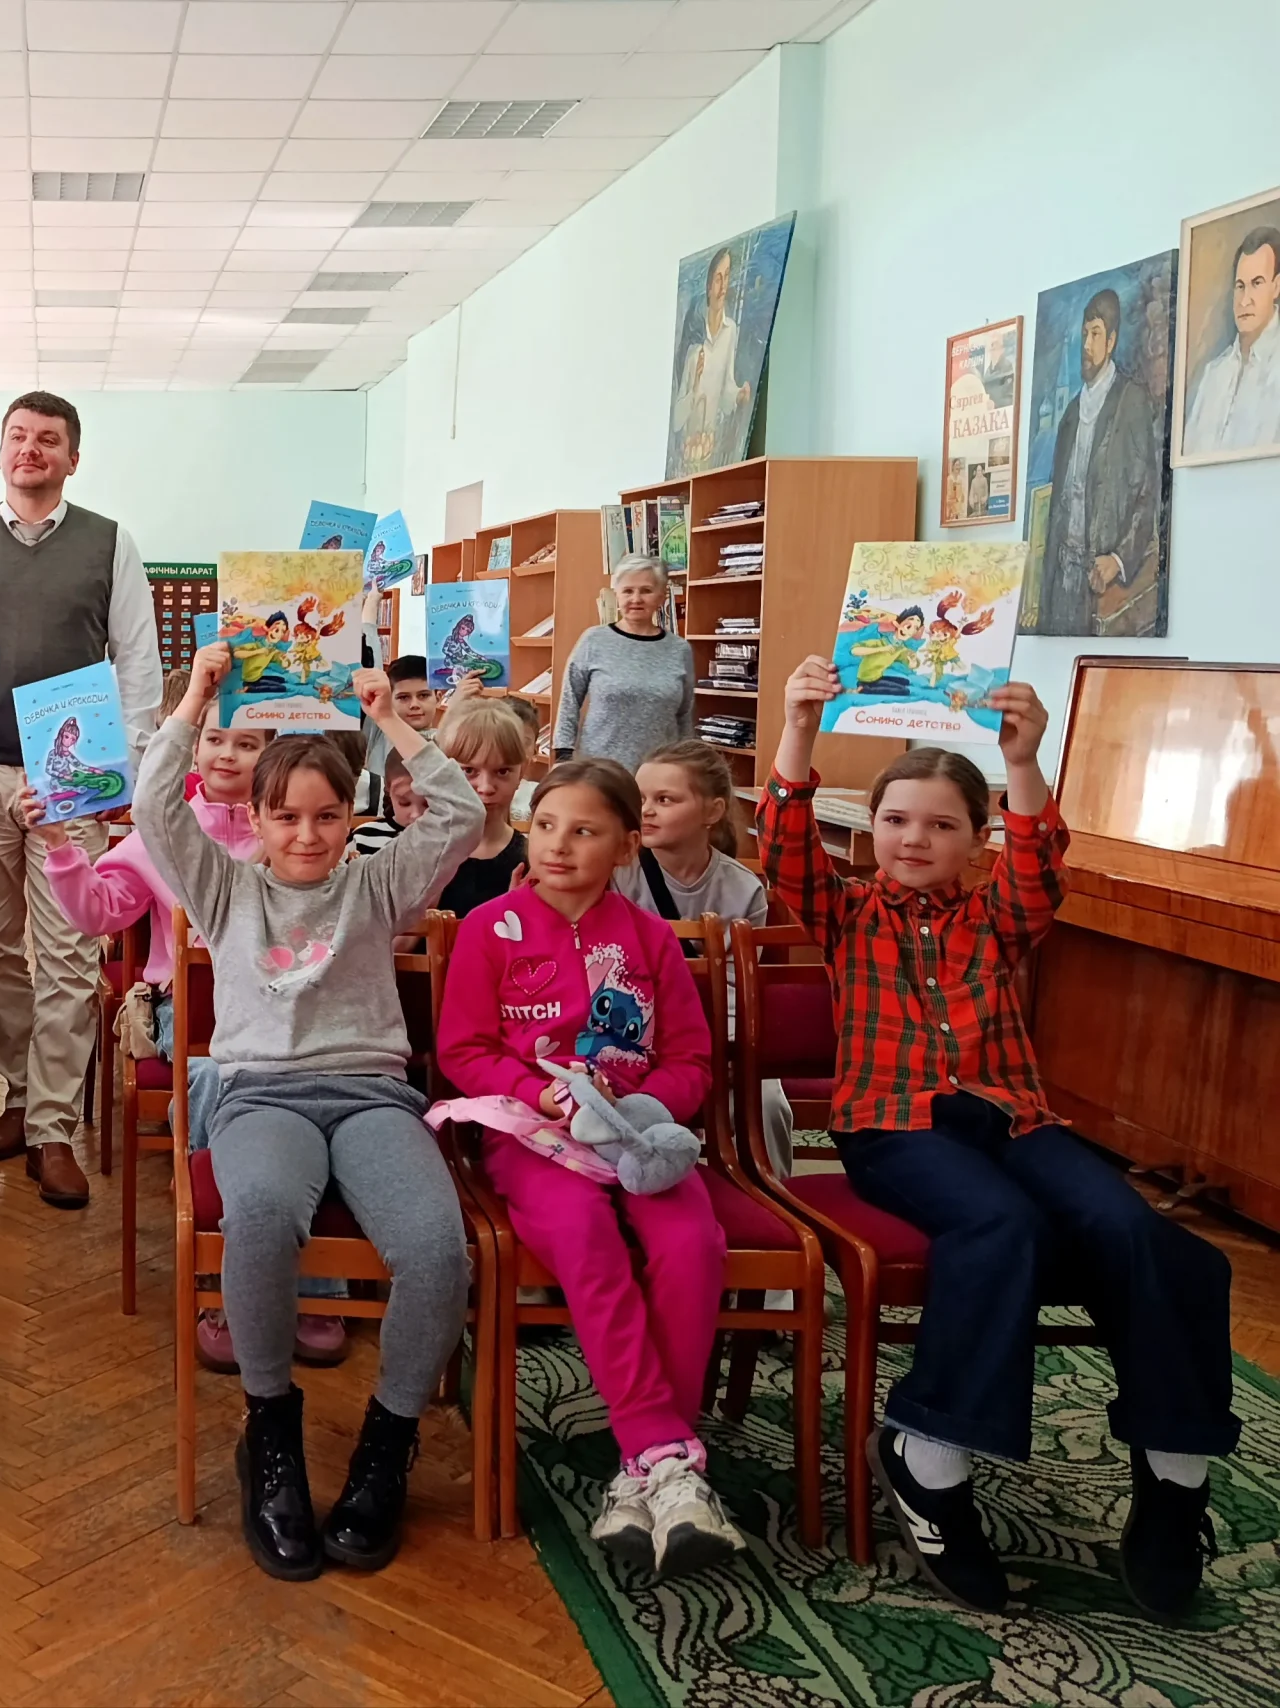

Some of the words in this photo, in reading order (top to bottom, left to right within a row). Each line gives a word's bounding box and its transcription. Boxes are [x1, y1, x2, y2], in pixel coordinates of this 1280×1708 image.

[951, 393, 984, 411] Сяргея
[953, 409, 1009, 439] КАЗАКА
[144, 566, 178, 575] АФІЧНЫ
[180, 567, 214, 575] АПАРАТ
[431, 602, 460, 613] ДЕВОЧКА
[24, 704, 59, 724] ДЕВОЧКА
[68, 694, 108, 706] КРОКОДИЛ
[246, 707, 285, 719] Сонино
[288, 712, 331, 720] детство
[855, 710, 903, 726] Сонино
[907, 719, 961, 730] детство
